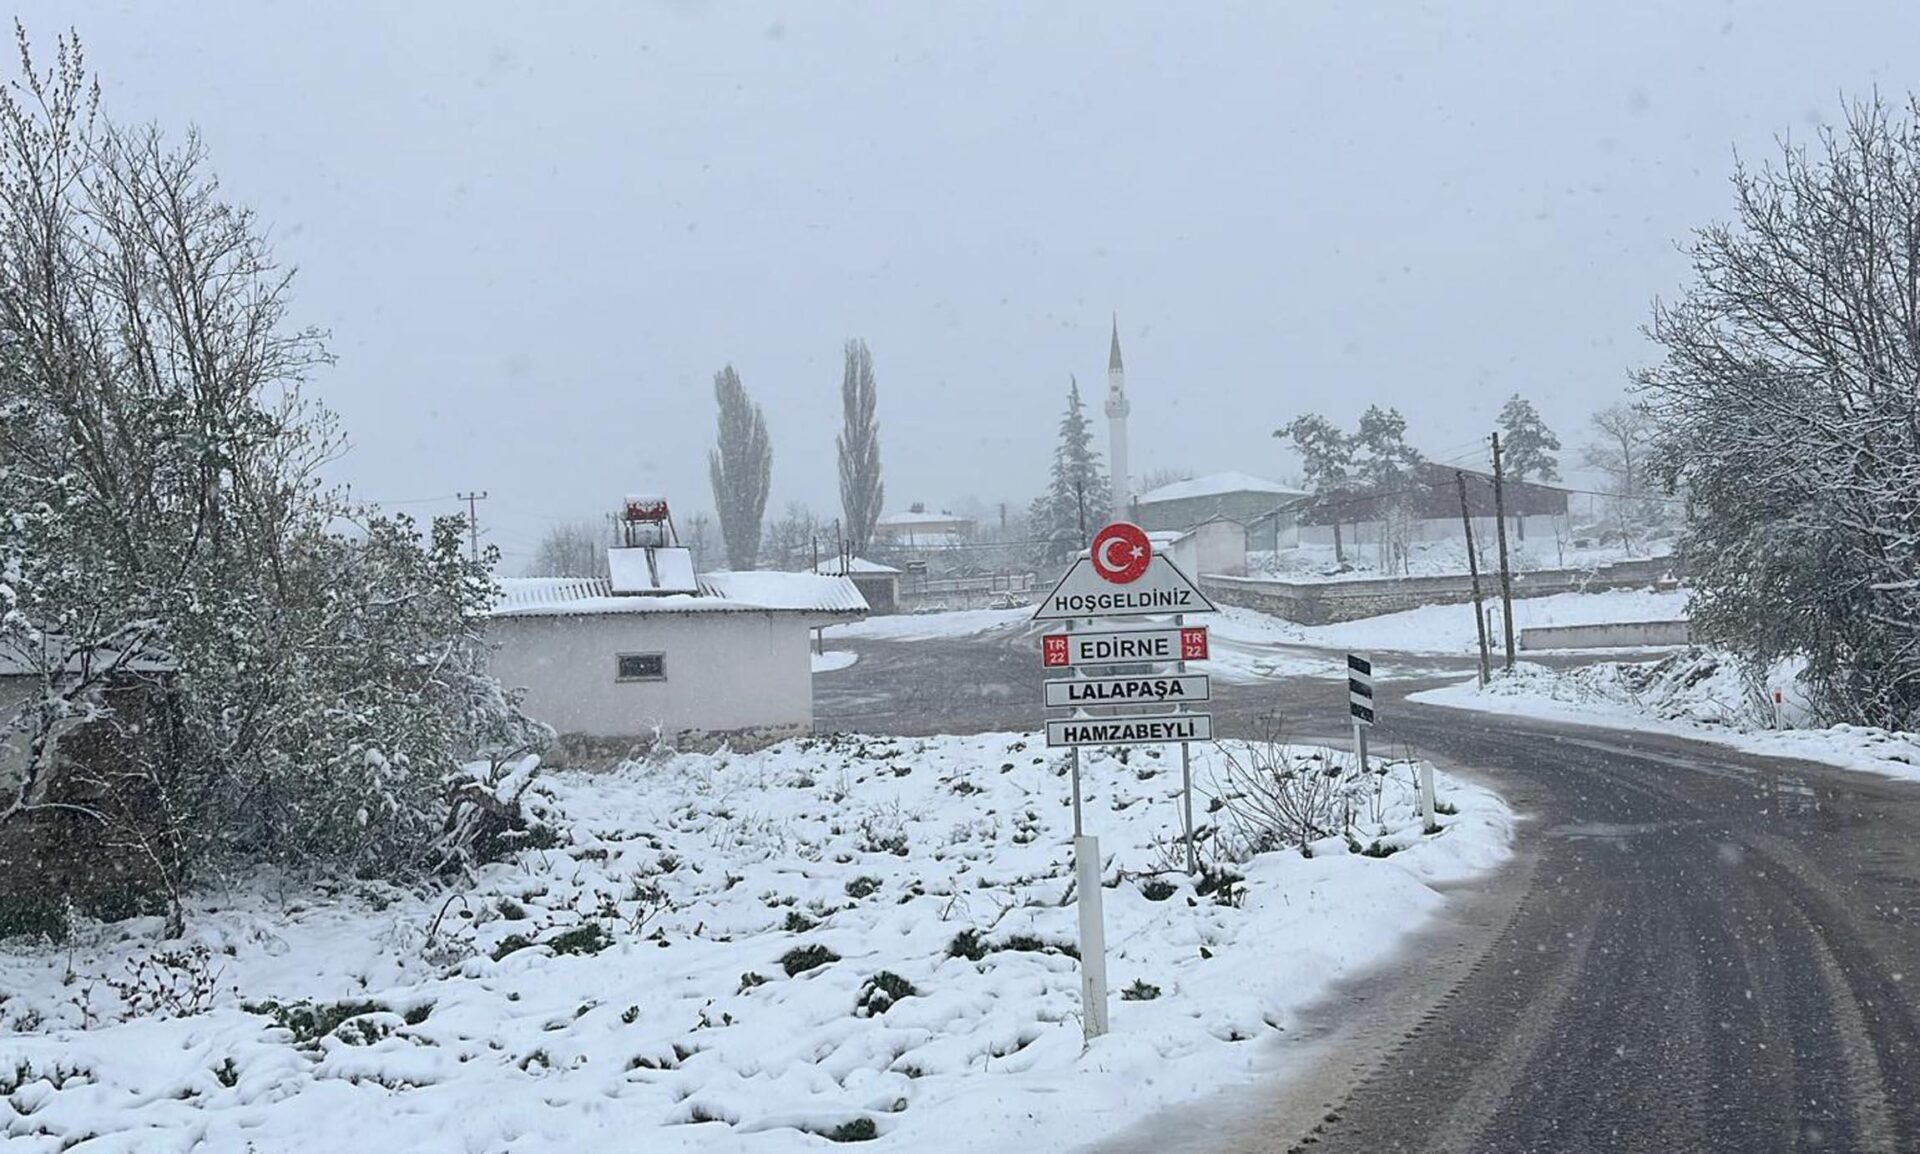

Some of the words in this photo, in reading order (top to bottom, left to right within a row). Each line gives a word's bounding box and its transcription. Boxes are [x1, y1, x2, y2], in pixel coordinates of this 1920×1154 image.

[1055, 587, 1191, 612] HOŞGELDİNİZ
[1047, 639, 1065, 651] TR
[1183, 632, 1202, 644] TR
[1080, 636, 1169, 659] EDİRNE
[1186, 645, 1201, 657] 22
[1050, 652, 1065, 664] 22
[1068, 679, 1184, 700] LALAPAŞA
[1064, 718, 1195, 742] HAMZABEYLİ
